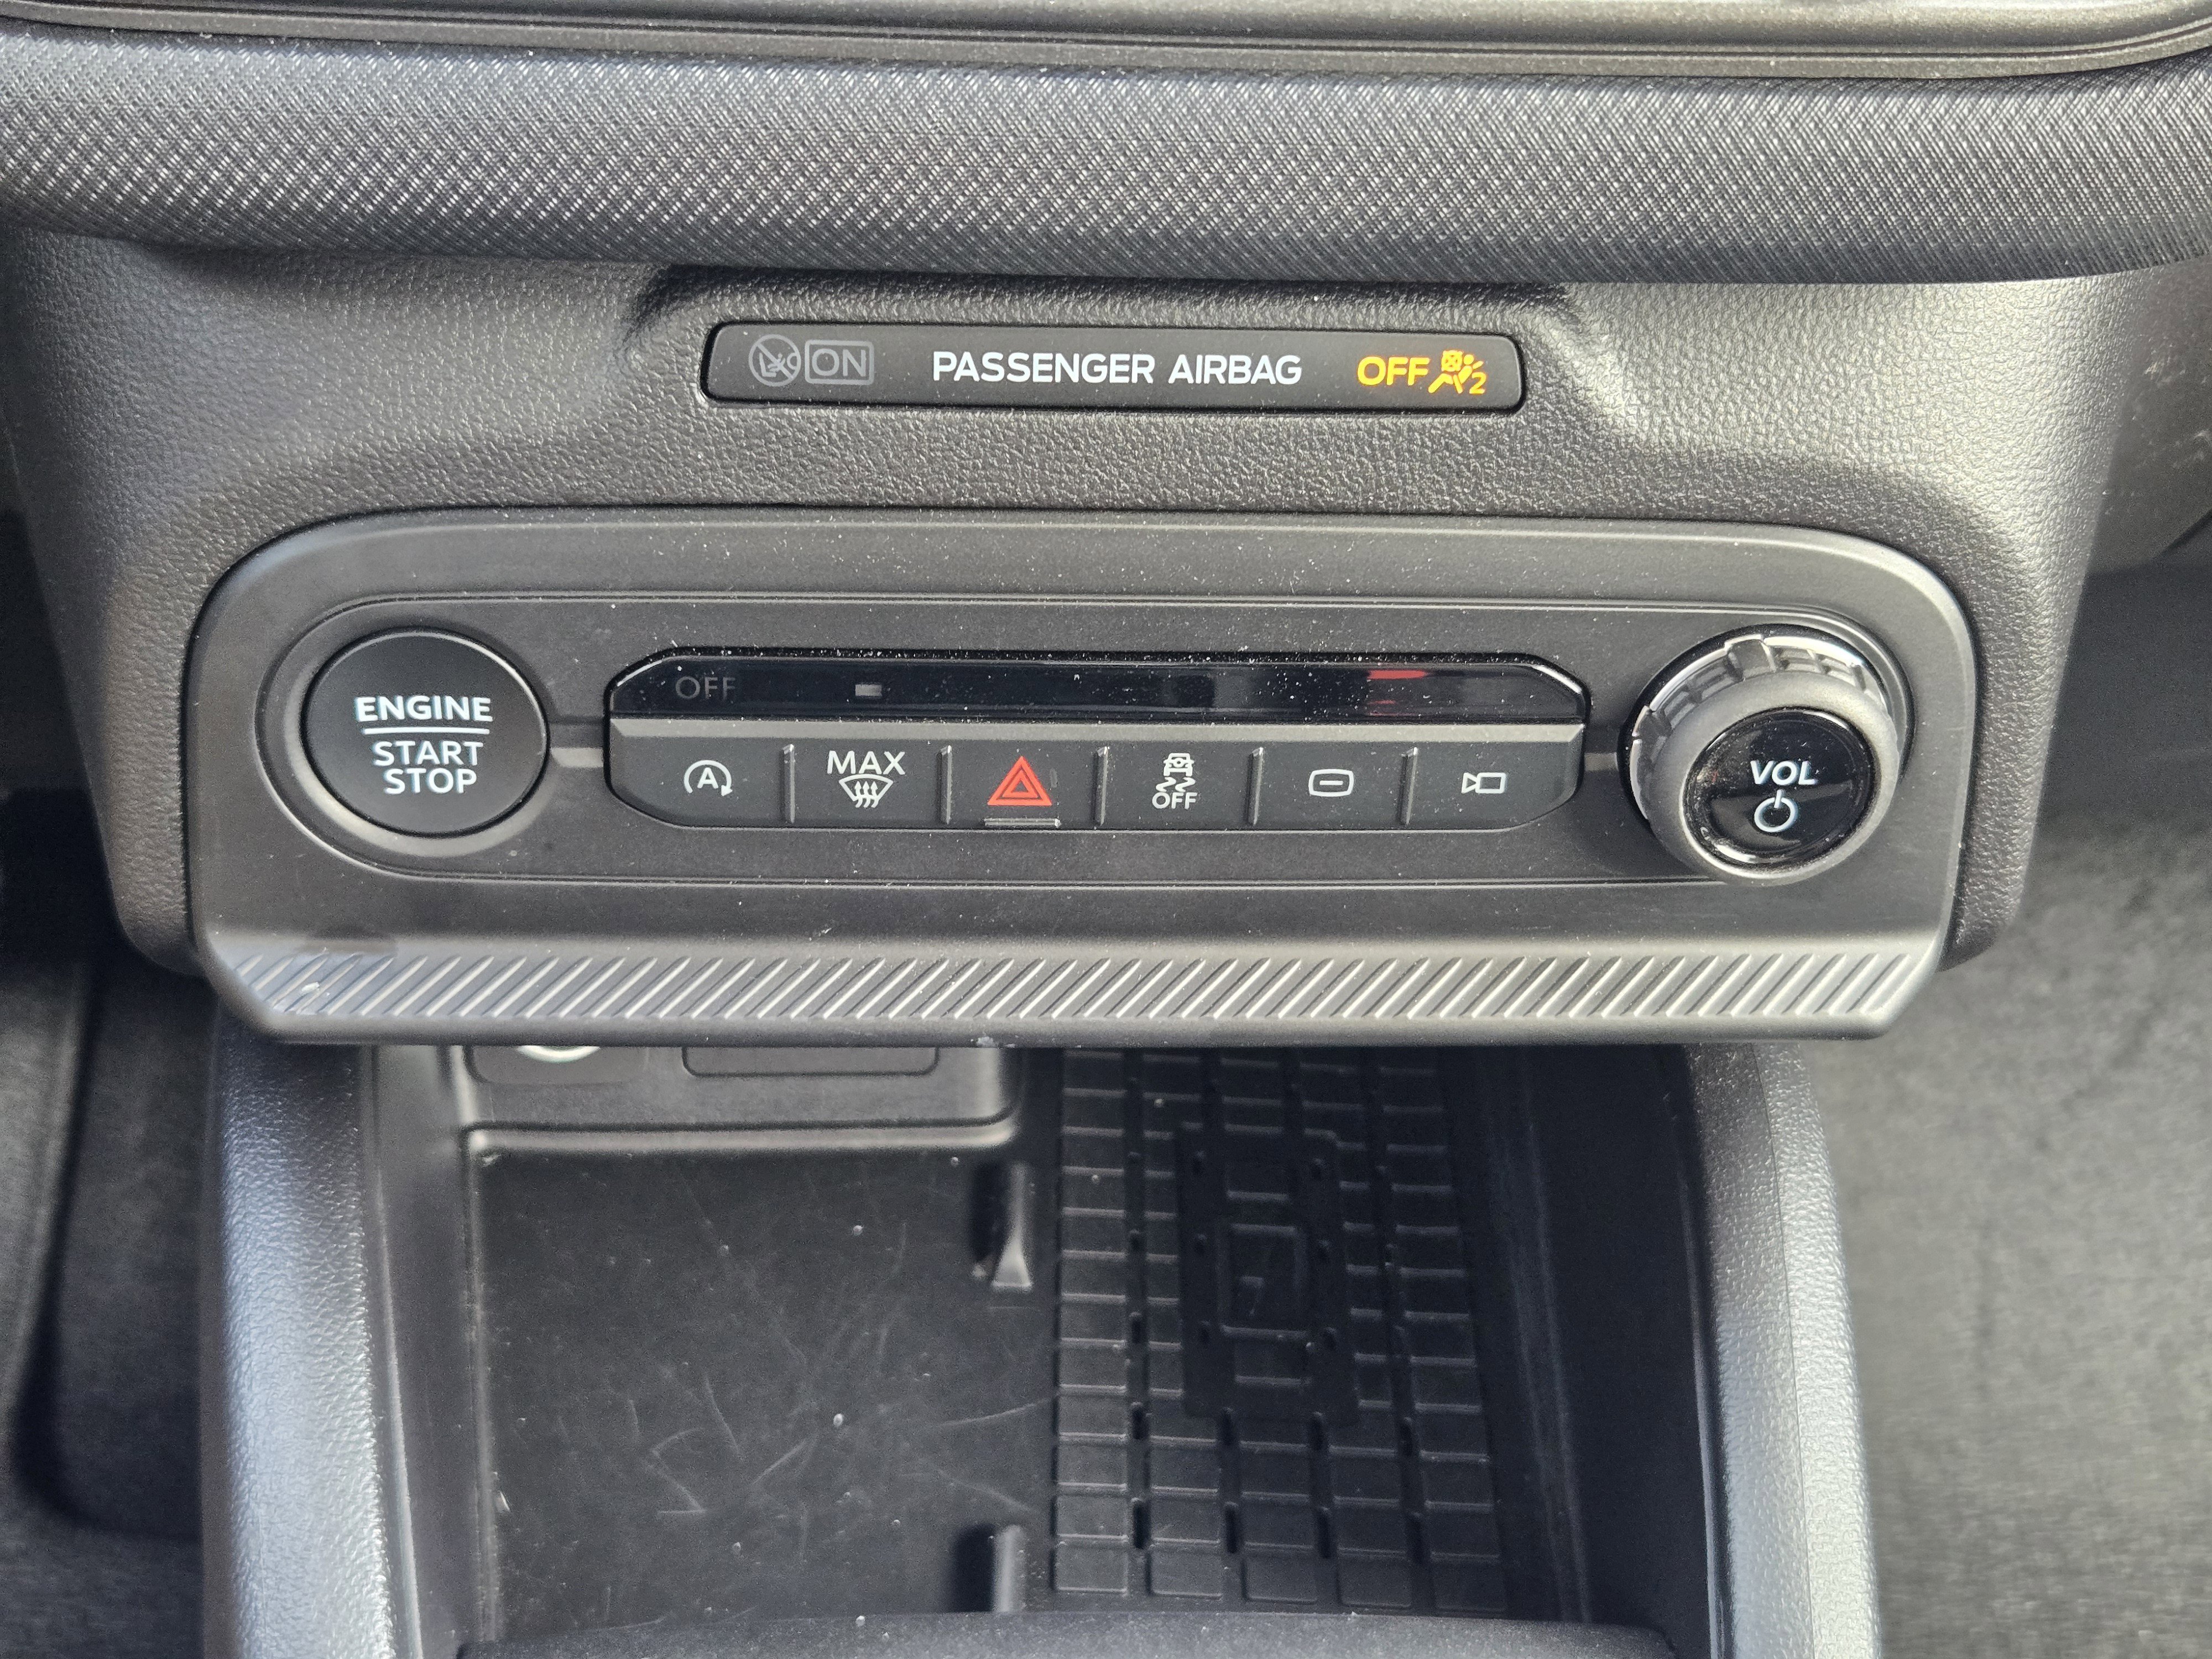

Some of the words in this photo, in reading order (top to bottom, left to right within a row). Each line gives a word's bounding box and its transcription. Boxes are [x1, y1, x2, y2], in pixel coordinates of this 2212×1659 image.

[811, 348, 866, 377] ON
[933, 351, 1155, 383] PASSENGER
[1168, 354, 1302, 385] AIRBAG
[1357, 356, 1430, 386] OFF
[675, 676, 736, 700] OFF
[354, 695, 493, 722] ENGINE
[373, 740, 484, 766] START
[827, 750, 906, 775] MAX
[384, 768, 477, 795] STOP
[1750, 759, 1819, 786] VOL
[1151, 791, 1198, 810] OFF
